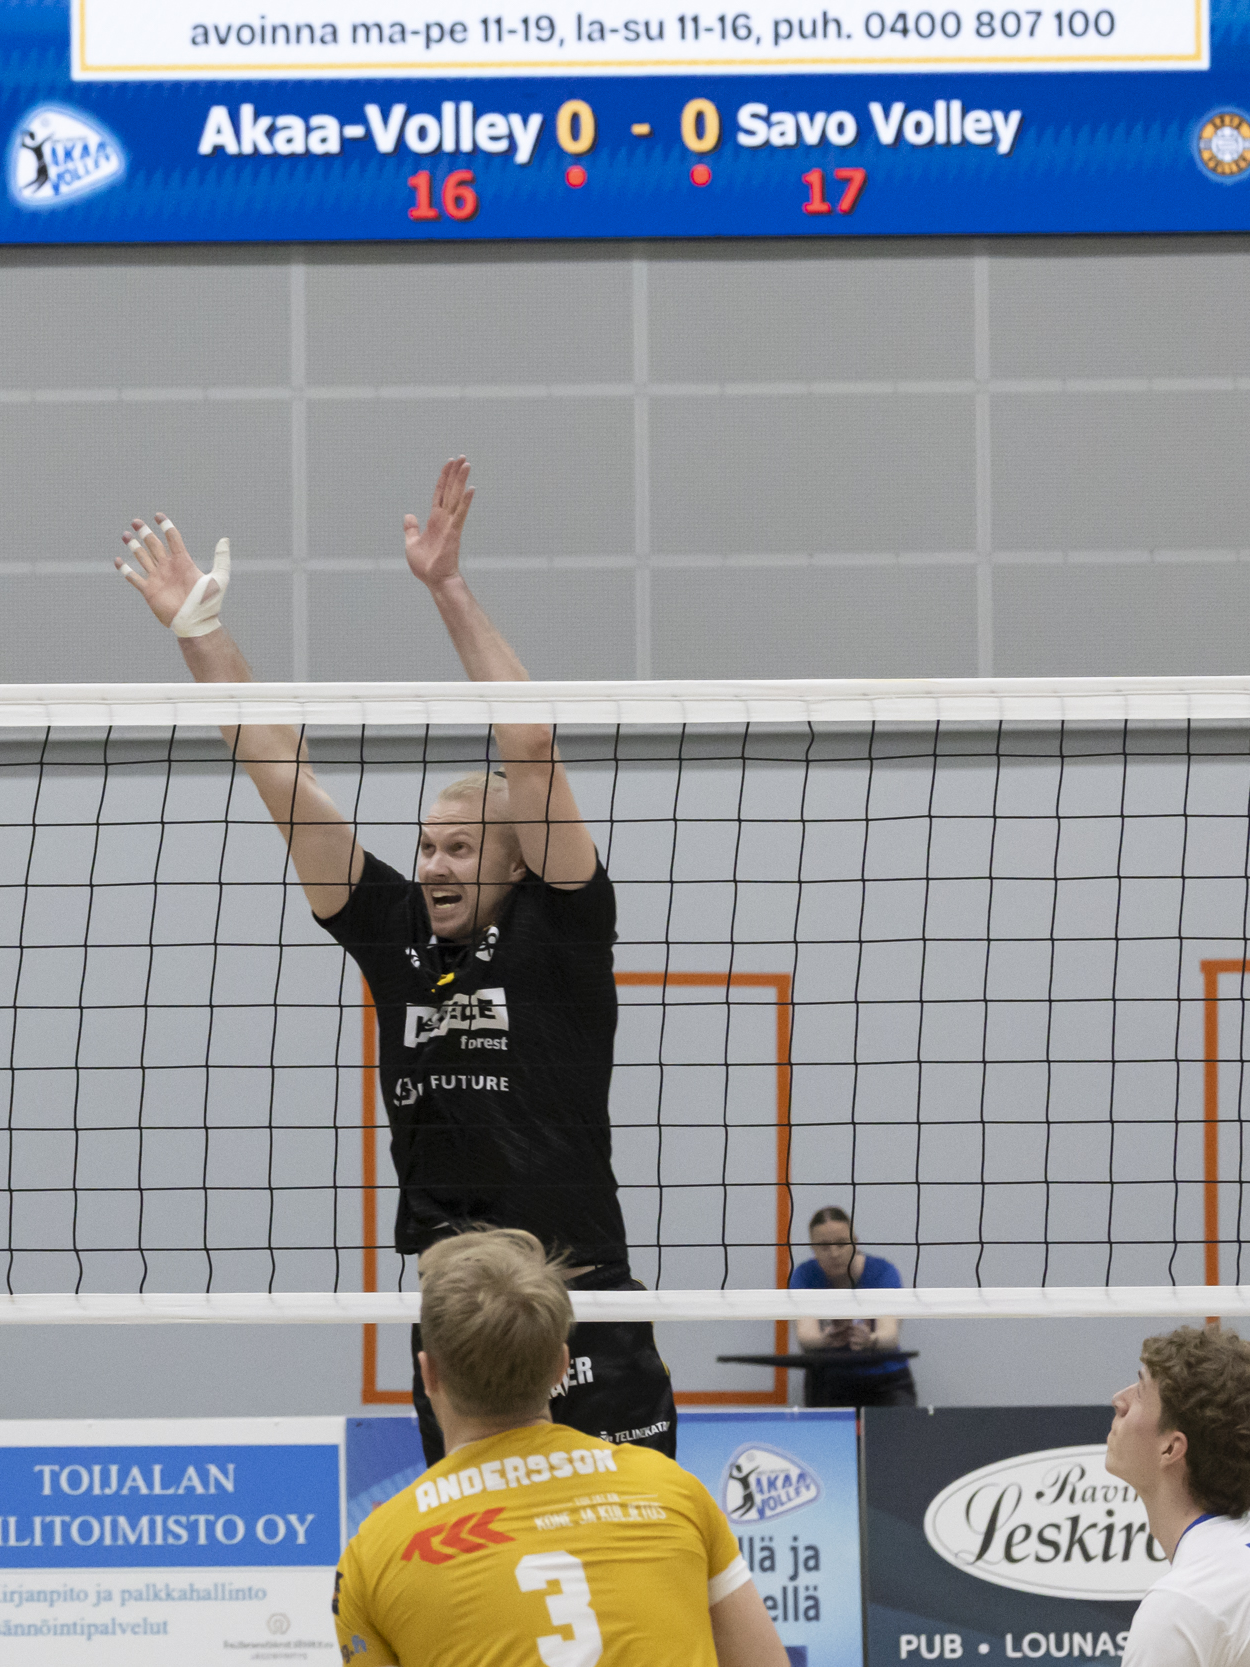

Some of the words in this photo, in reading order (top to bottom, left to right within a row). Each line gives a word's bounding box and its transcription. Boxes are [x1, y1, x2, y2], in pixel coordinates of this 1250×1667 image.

[191, 15, 338, 46] avoinna
[352, 20, 468, 50] ma-pe
[480, 15, 564, 48] 11-19,
[577, 13, 664, 42] la-su
[678, 13, 761, 46] 11-16,
[773, 10, 852, 46] puh.
[864, 11, 962, 38] 0400
[975, 10, 1042, 38] 807
[1053, 9, 1116, 38] 100
[198, 101, 544, 164] Akaa-Volley
[555, 99, 595, 154] 0
[680, 98, 721, 153] 0
[736, 102, 858, 147] Savo
[868, 100, 1023, 155] Volley
[408, 169, 479, 220] 16
[801, 167, 867, 214] 17
[460, 1035, 508, 1050] forest
[430, 1075, 510, 1091] FUTURE
[33, 1463, 236, 1496] TOIJALAN
[255, 1513, 315, 1545] OY
[789, 1536, 820, 1581] ja
[92, 1584, 114, 1607] ja
[119, 1582, 268, 1607] palkkahallinto
[514, 1550, 604, 1667] 3
[900, 1633, 964, 1660] PUB
[1005, 1630, 1130, 1659] LOUNAS
